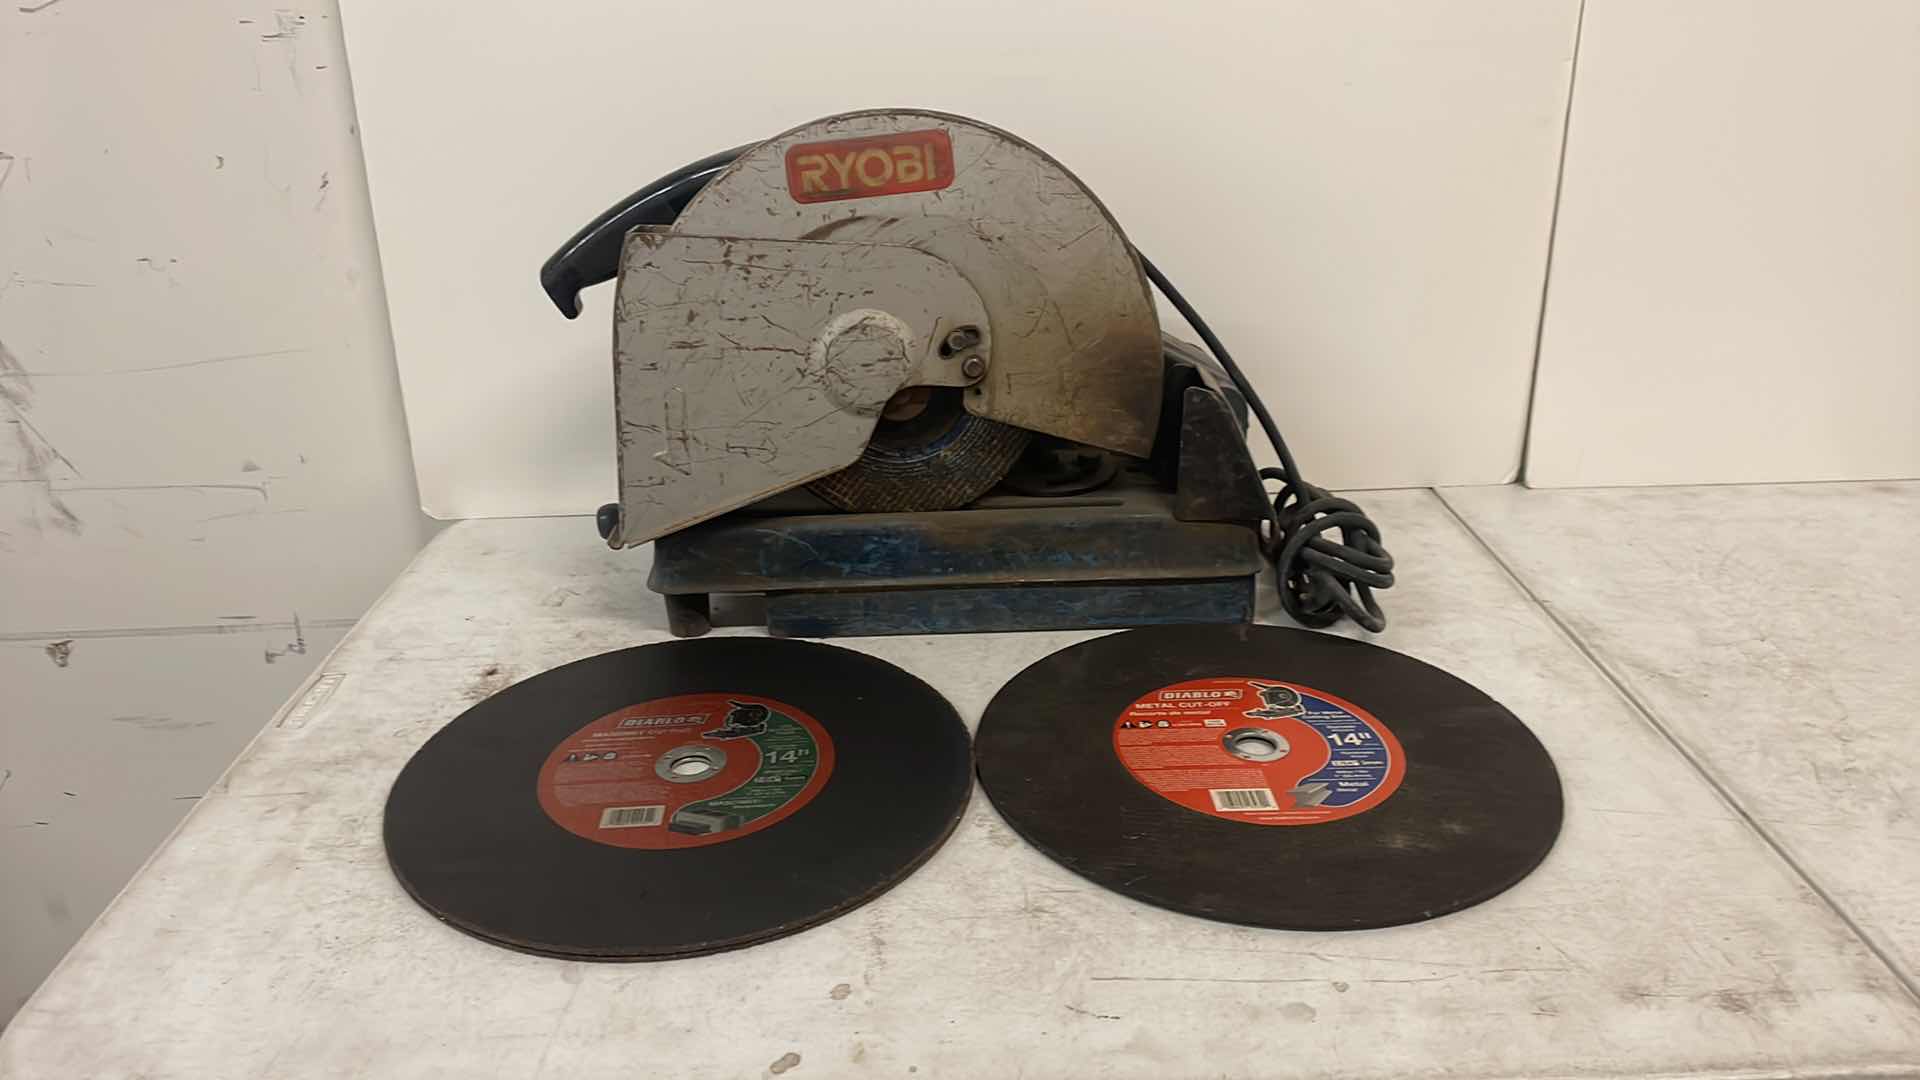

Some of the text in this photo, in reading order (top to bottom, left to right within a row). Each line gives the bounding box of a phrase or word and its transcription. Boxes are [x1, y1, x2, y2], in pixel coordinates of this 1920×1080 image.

[796, 143, 937, 194] RYOBI
[1163, 690, 1222, 700] DIABLO
[1327, 732, 1372, 746] 14"
[764, 749, 809, 764] 14"
